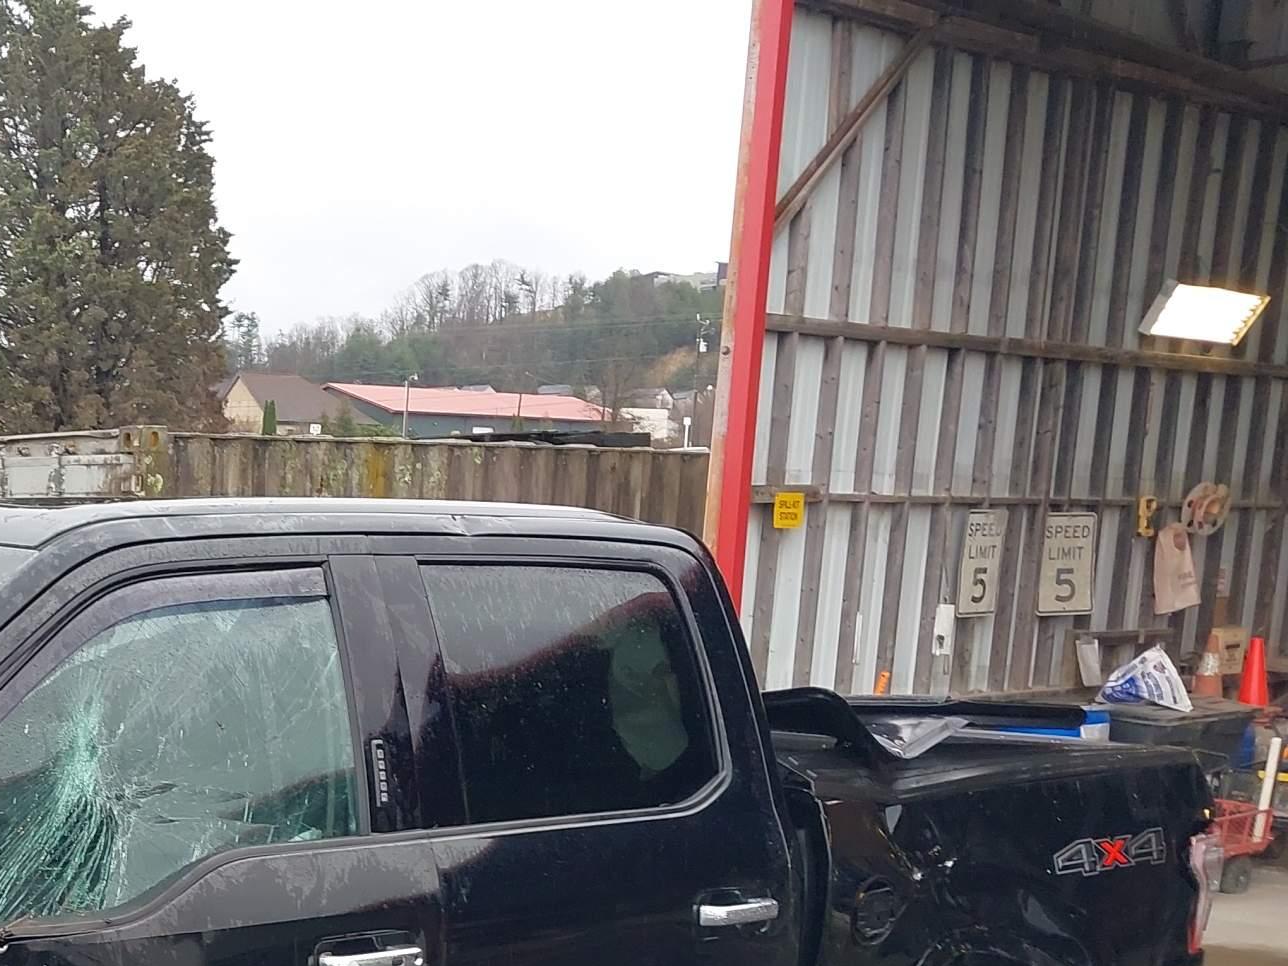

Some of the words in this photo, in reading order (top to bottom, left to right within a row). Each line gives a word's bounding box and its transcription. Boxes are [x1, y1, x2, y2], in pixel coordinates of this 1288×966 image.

[968, 522, 1002, 537] SPEED
[1046, 525, 1090, 539] SPEED
[968, 545, 997, 560] LIMIT
[1048, 546, 1084, 560] LIMIT
[971, 567, 988, 603] 5
[1054, 568, 1076, 602] 5
